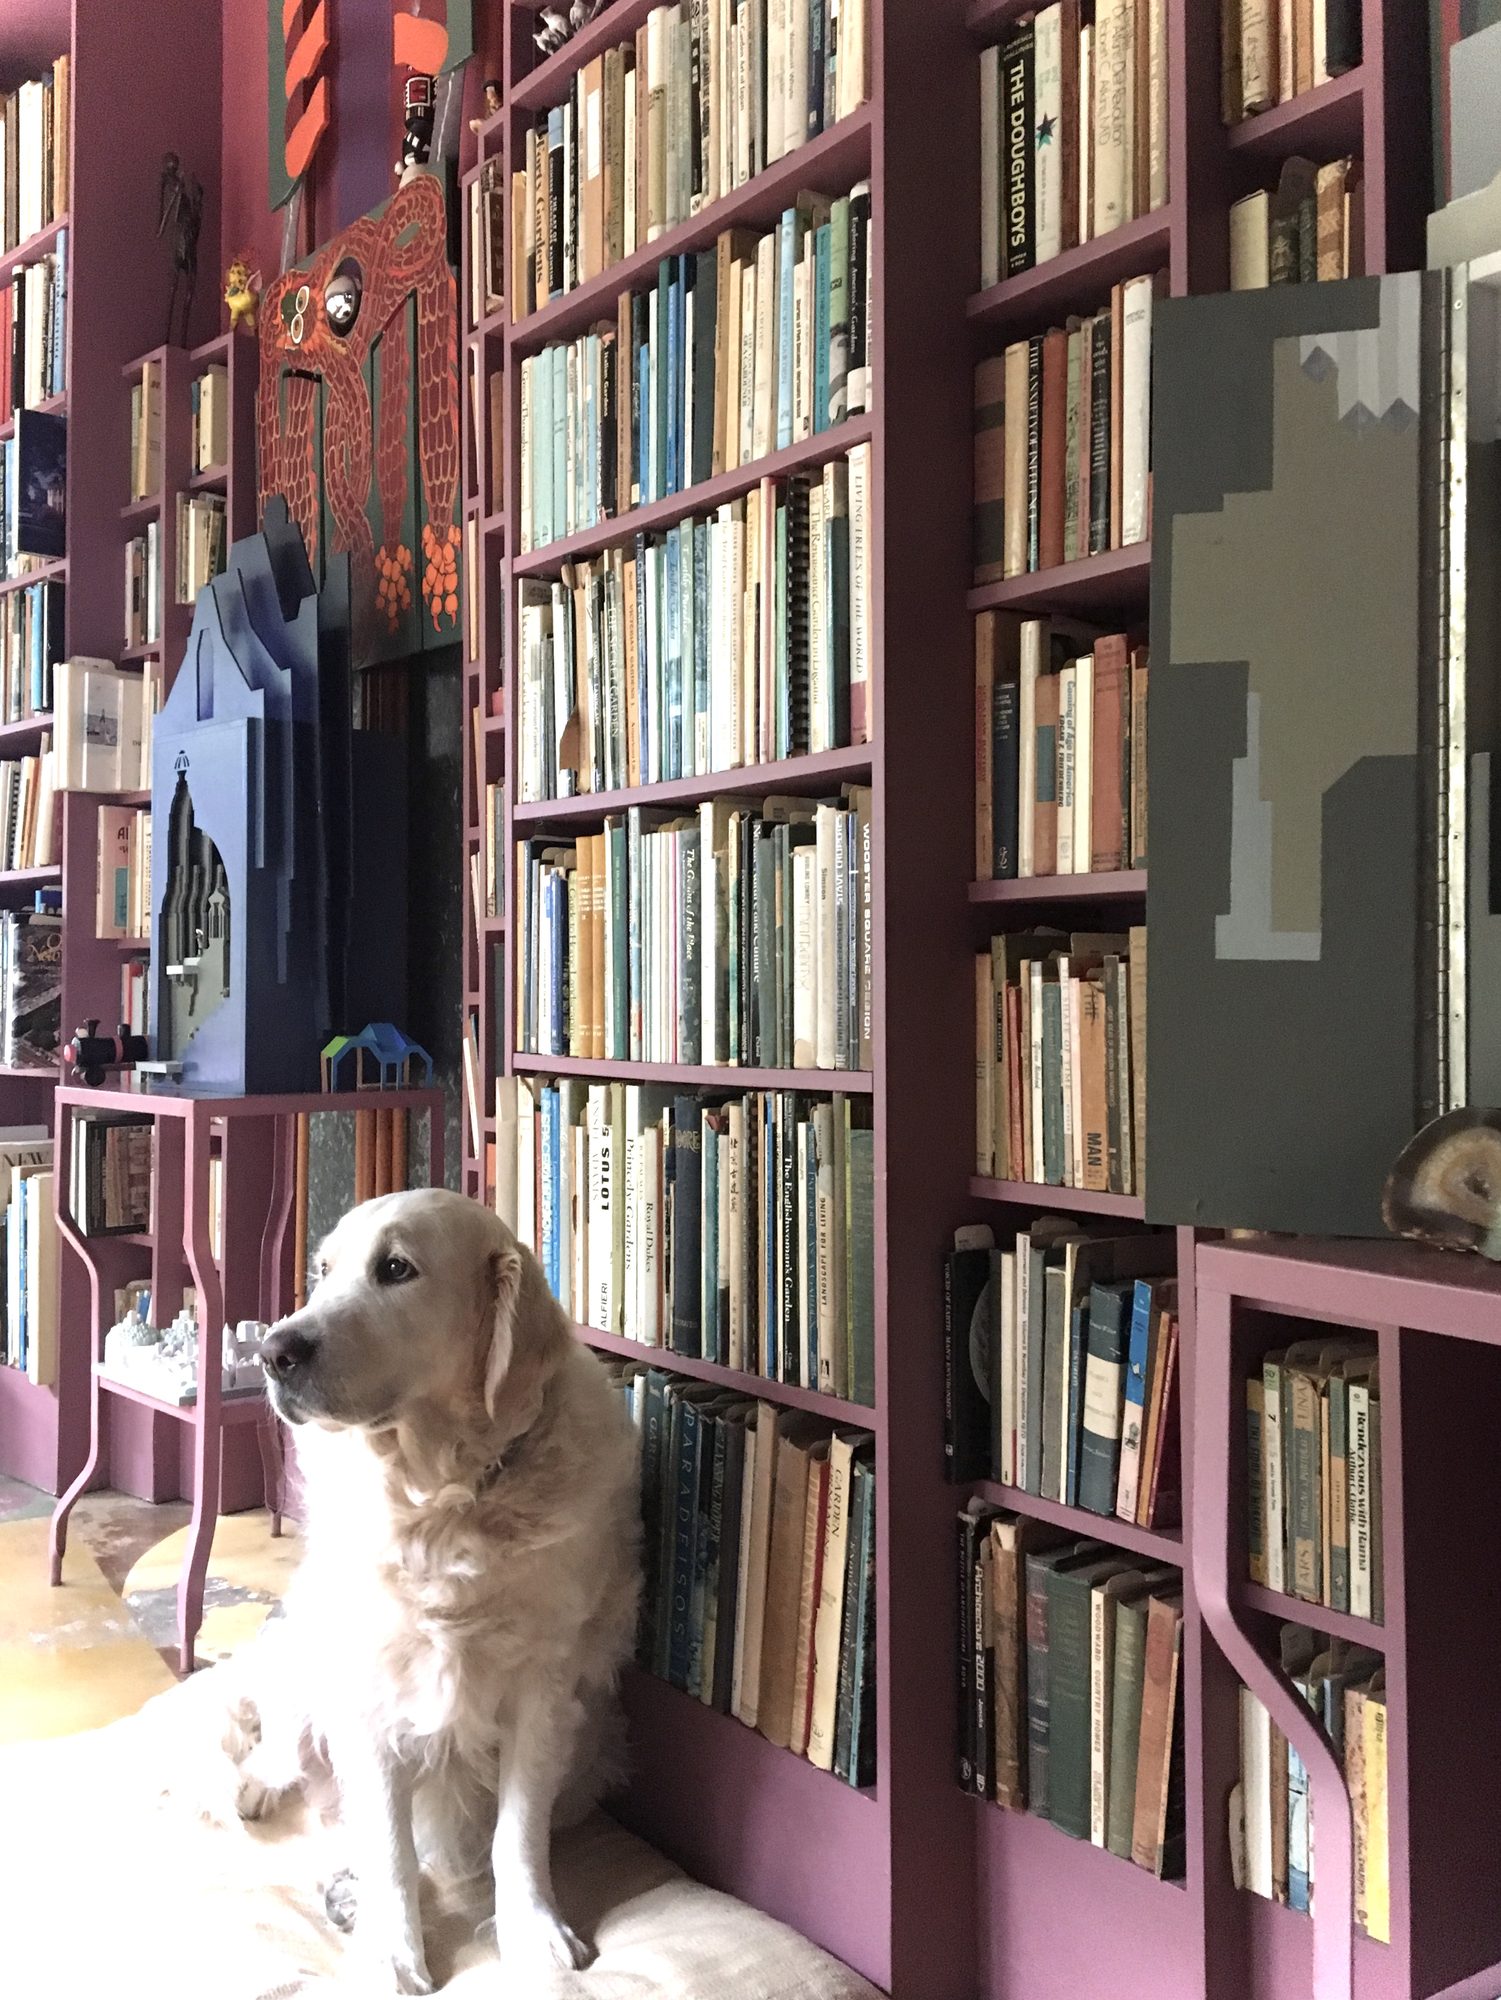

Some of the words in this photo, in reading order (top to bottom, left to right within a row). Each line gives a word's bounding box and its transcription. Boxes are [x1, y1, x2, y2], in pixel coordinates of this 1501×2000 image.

[739, 8, 747, 23] The
[738, 87, 746, 112] Japan
[739, 75, 746, 85] of
[1010, 60, 1025, 106] THE
[1112, 86, 1126, 148] Revolution
[536, 139, 547, 187] Forty
[1010, 107, 1030, 246] DOUGHBOYS
[536, 196, 547, 285] Gardens
[849, 216, 859, 262] Exploring
[850, 267, 859, 311] America's
[850, 315, 858, 354] Gardens
[1028, 343, 1040, 371] THE
[1028, 374, 1039, 430] ANXIETY
[1028, 431, 1039, 451] OF
[855, 475, 864, 523] LIVING
[1028, 451, 1038, 519] INFLUENCE
[811, 511, 821, 532] The
[811, 533, 821, 599] Renaissance
[855, 528, 863, 571] TREES
[855, 575, 863, 592] OF
[811, 601, 821, 643] Garden
[855, 627, 863, 674] WORLD
[609, 683, 619, 738] GARDEN
[1066, 680, 1076, 718] Coming
[1066, 719, 1076, 731] of
[1066, 732, 1076, 751] Age
[1067, 753, 1076, 762] in
[1066, 763, 1076, 807] America
[686, 848, 695, 867] The
[862, 822, 871, 904] WOOSTER
[568, 887, 577, 921] Guide
[686, 917, 695, 933] the
[568, 922, 576, 933] to
[863, 909, 871, 975] SQUARE
[568, 935, 577, 964] Home
[753, 936, 761, 984] Culture
[567, 964, 577, 1042] Landscaping
[624, 1138, 634, 1201] Princely
[783, 1155, 793, 1183] The
[1087, 1132, 1102, 1167] MAN
[601, 1147, 610, 1212] LOTUS
[644, 1202, 654, 1235] Royal
[783, 1184, 793, 1276] Englishwoman's
[819, 1197, 827, 1227] LIVING
[625, 1205, 634, 1271] Gardens
[645, 1237, 654, 1274] Dukes
[601, 1281, 609, 1328] ALFIERI
[783, 1276, 793, 1322] Garden
[945, 1292, 951, 1303] OF
[1268, 1413, 1277, 1422] 7
[1356, 1411, 1367, 1497] Rendezvous
[831, 1468, 843, 1537] GARDEN
[1358, 1498, 1368, 1528] with
[1298, 1548, 1309, 1583] ARS
[1358, 1530, 1367, 1573] Rama
[960, 1582, 966, 1592] OF
[975, 1564, 984, 1651] Architecture
[976, 1654, 985, 1692] 2000
